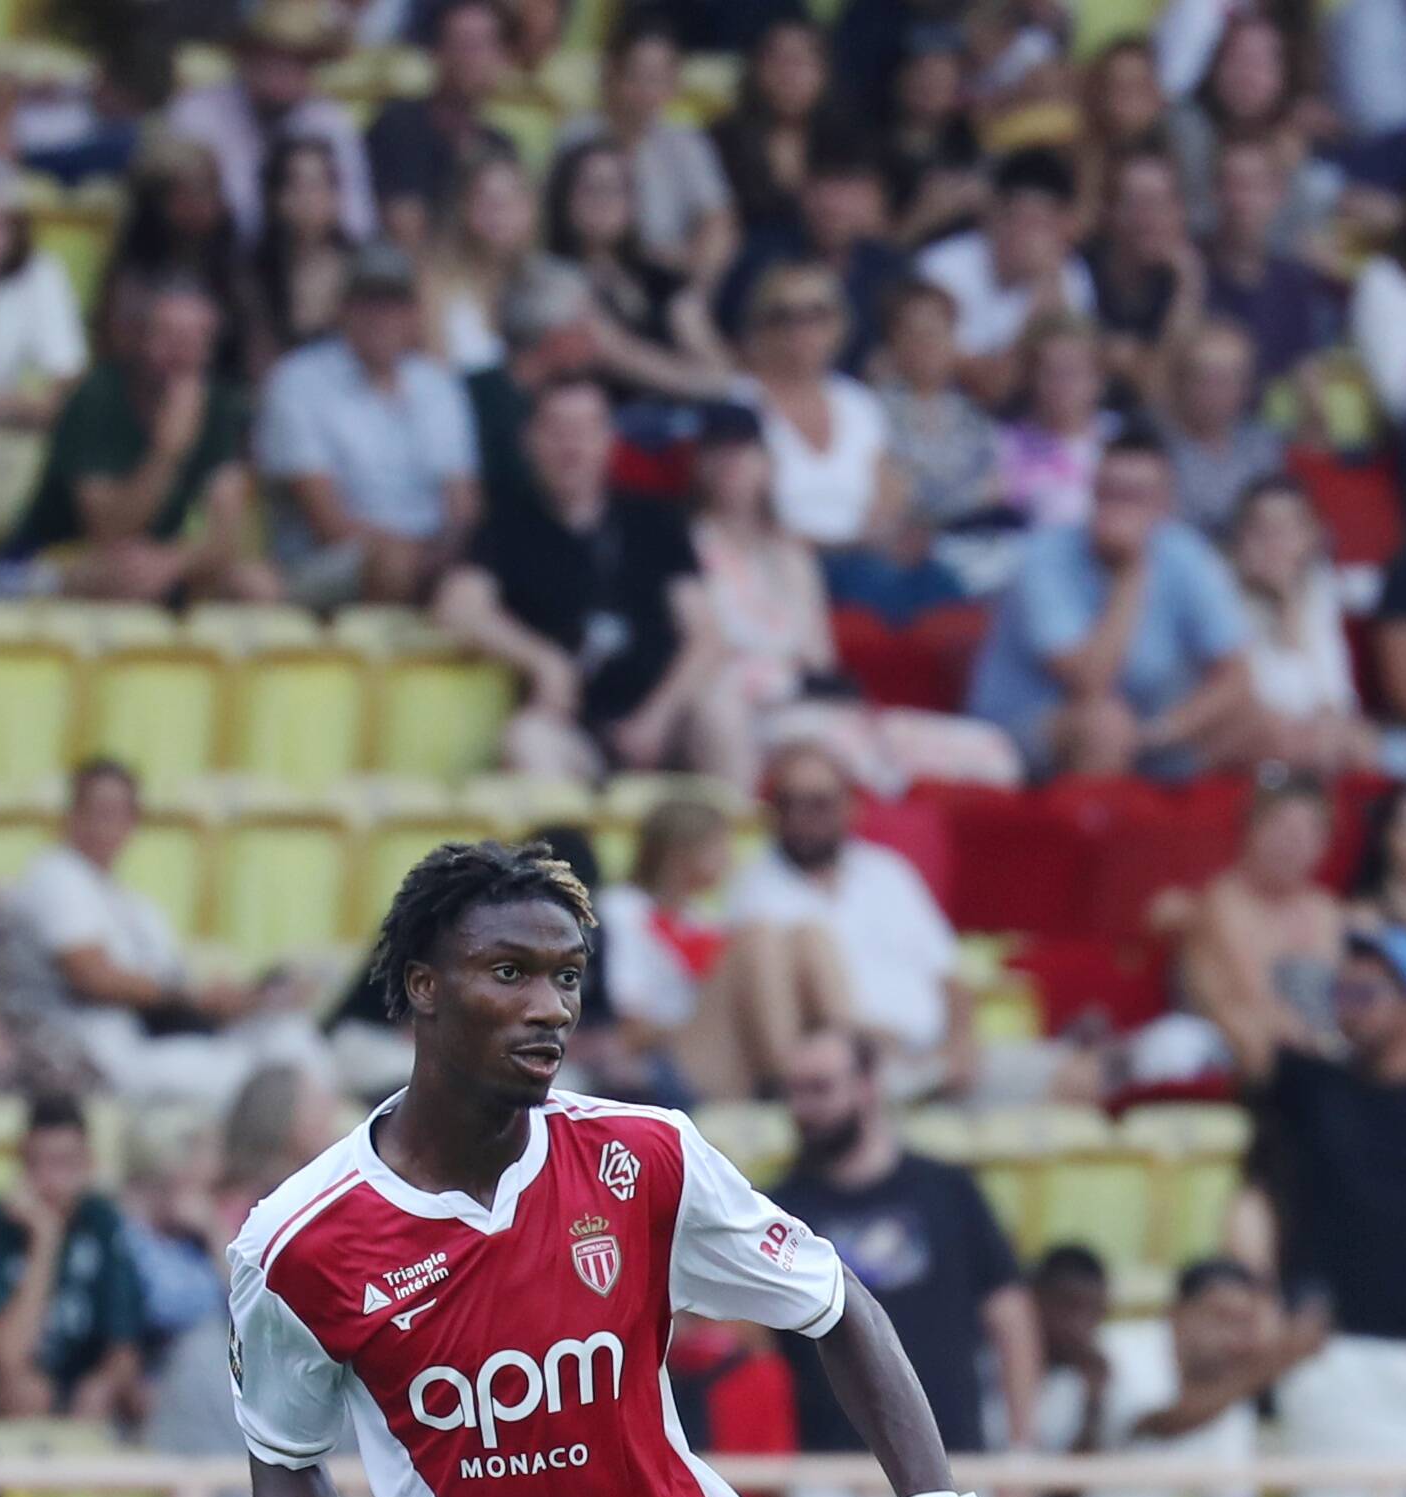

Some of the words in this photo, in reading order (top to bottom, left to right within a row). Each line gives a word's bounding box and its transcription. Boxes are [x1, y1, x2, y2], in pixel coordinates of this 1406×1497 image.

[382, 1252, 448, 1289] Triangle
[393, 1266, 450, 1302] intérim
[408, 1331, 624, 1449] apm
[460, 1443, 589, 1480] MONACO
